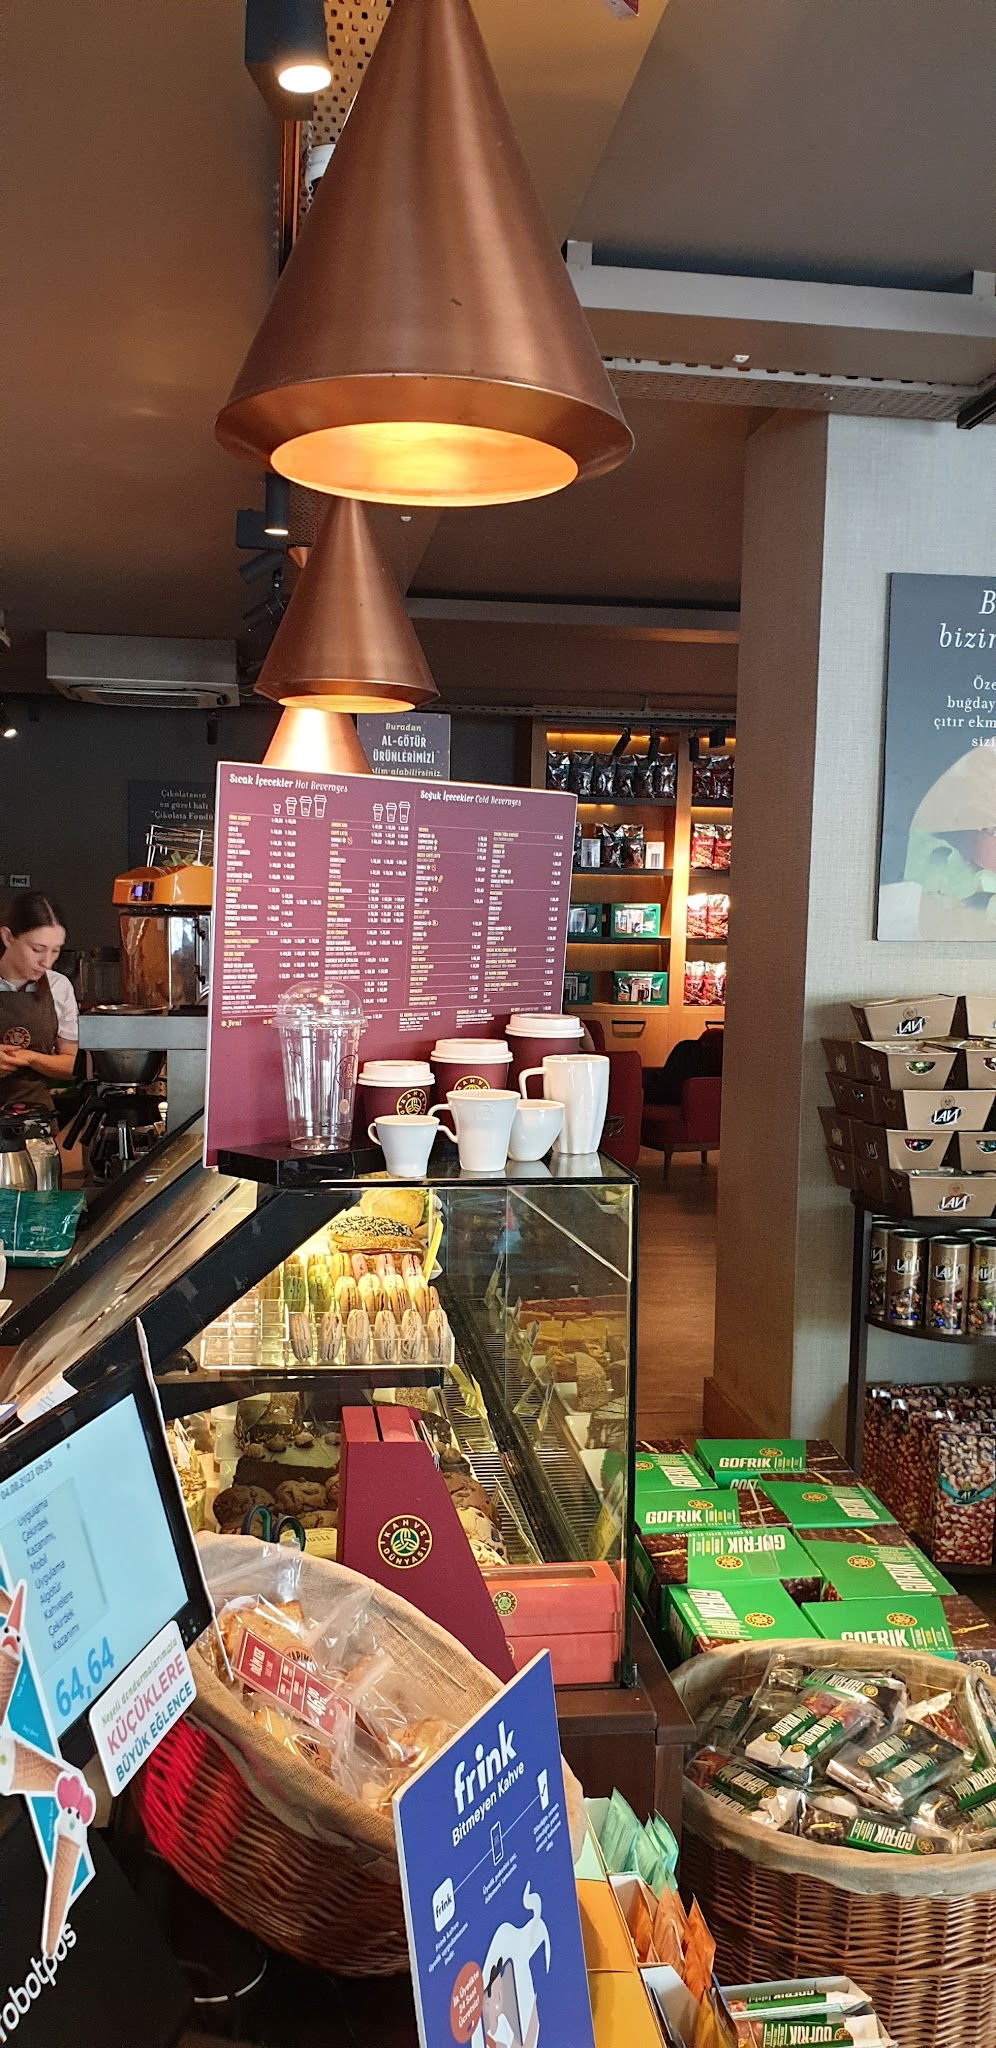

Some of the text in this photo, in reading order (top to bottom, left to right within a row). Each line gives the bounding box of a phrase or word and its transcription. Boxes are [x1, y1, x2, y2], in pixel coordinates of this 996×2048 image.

[385, 722, 422, 732] Buradan
[934, 717, 965, 730] çıtır
[381, 735, 427, 748] AL-GÖTÜR
[373, 748, 435, 764] ÜRÜNLERİMİZİ
[229, 773, 253, 785] Sıcak
[255, 773, 294, 788] İçecekler
[310, 781, 348, 794] Beverages
[420, 789, 442, 802] Soğuk
[384, 1519, 428, 1538] KAHVE
[56, 1636, 115, 1717] 64,64
[107, 1653, 186, 1756] KÜÇÜKLERE
[116, 1680, 193, 1783] BÜYÜK EĞLENCE
[454, 1720, 517, 1815] frink
[452, 1762, 525, 1847] Bitmeyen Kahve
[435, 1892, 453, 1919] frink
